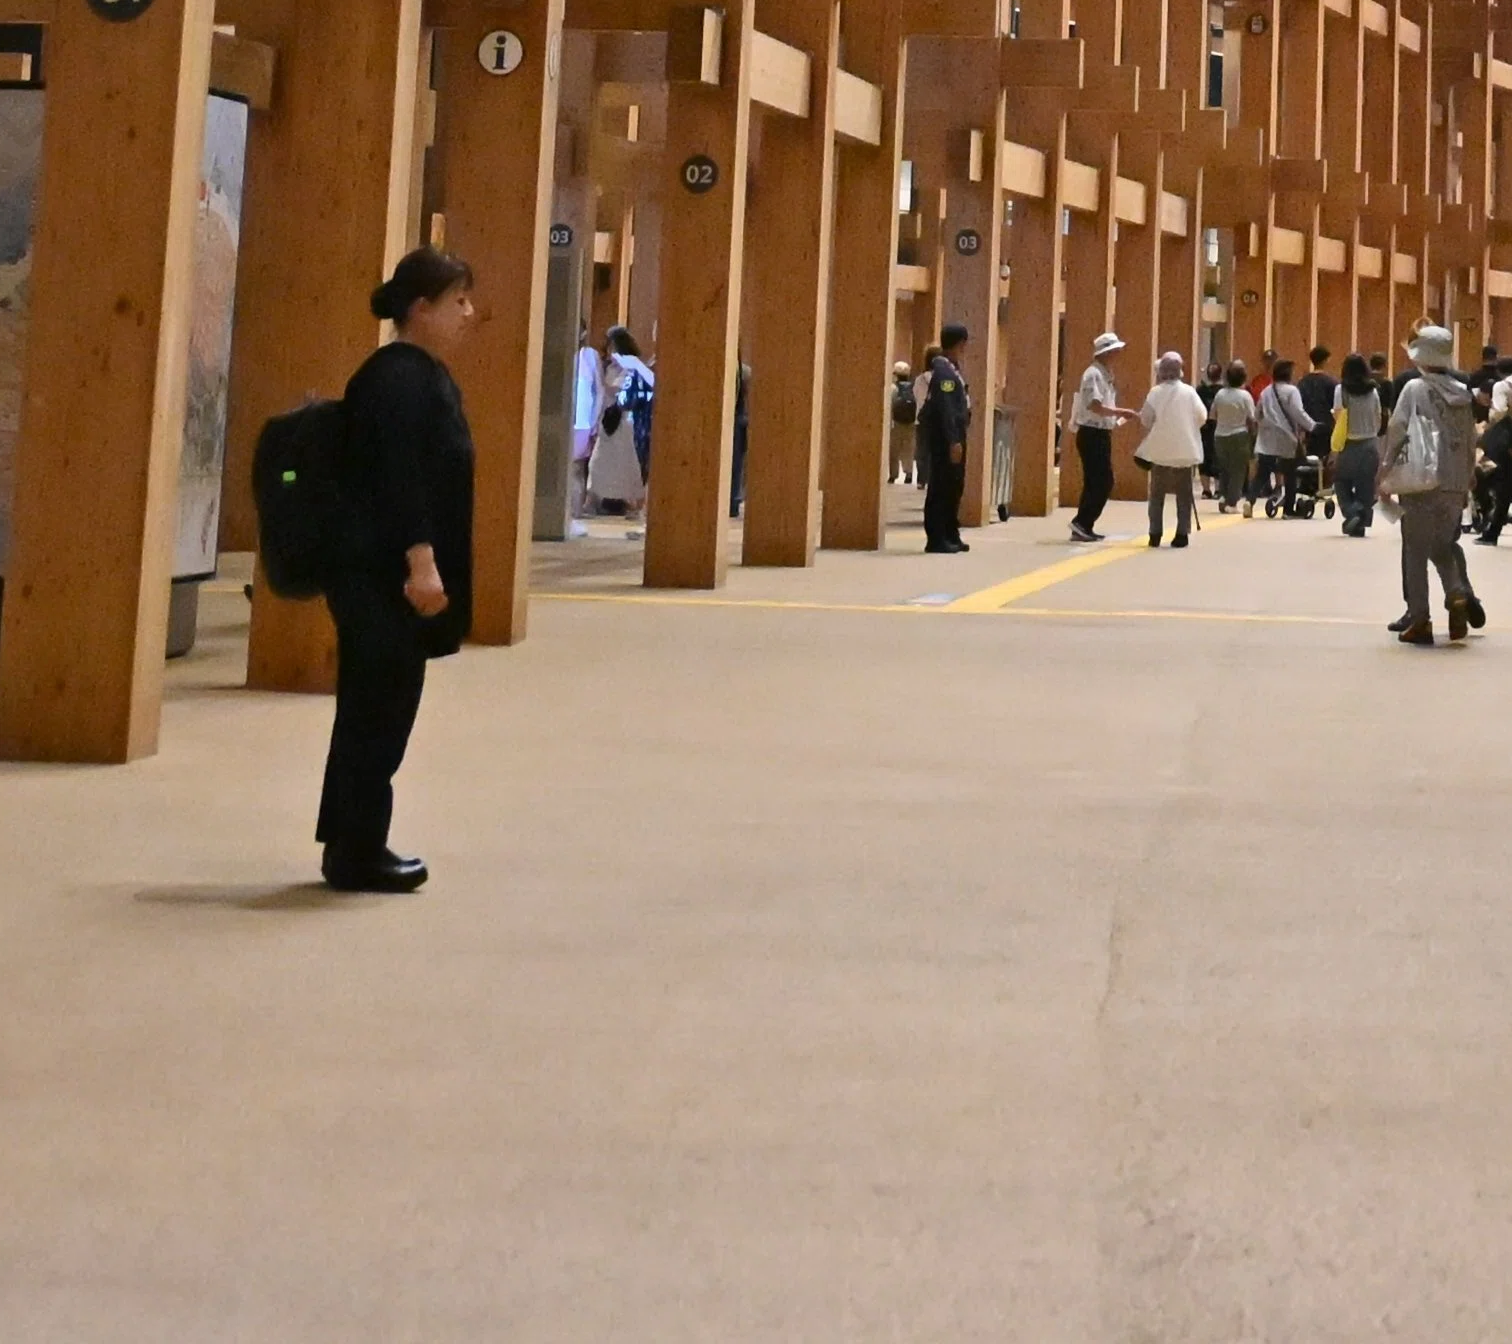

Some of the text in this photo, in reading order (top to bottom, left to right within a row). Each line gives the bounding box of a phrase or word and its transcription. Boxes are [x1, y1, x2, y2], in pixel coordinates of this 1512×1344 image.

[686, 164, 713, 184] 02
[551, 230, 569, 244] 03
[959, 236, 977, 250] 03
